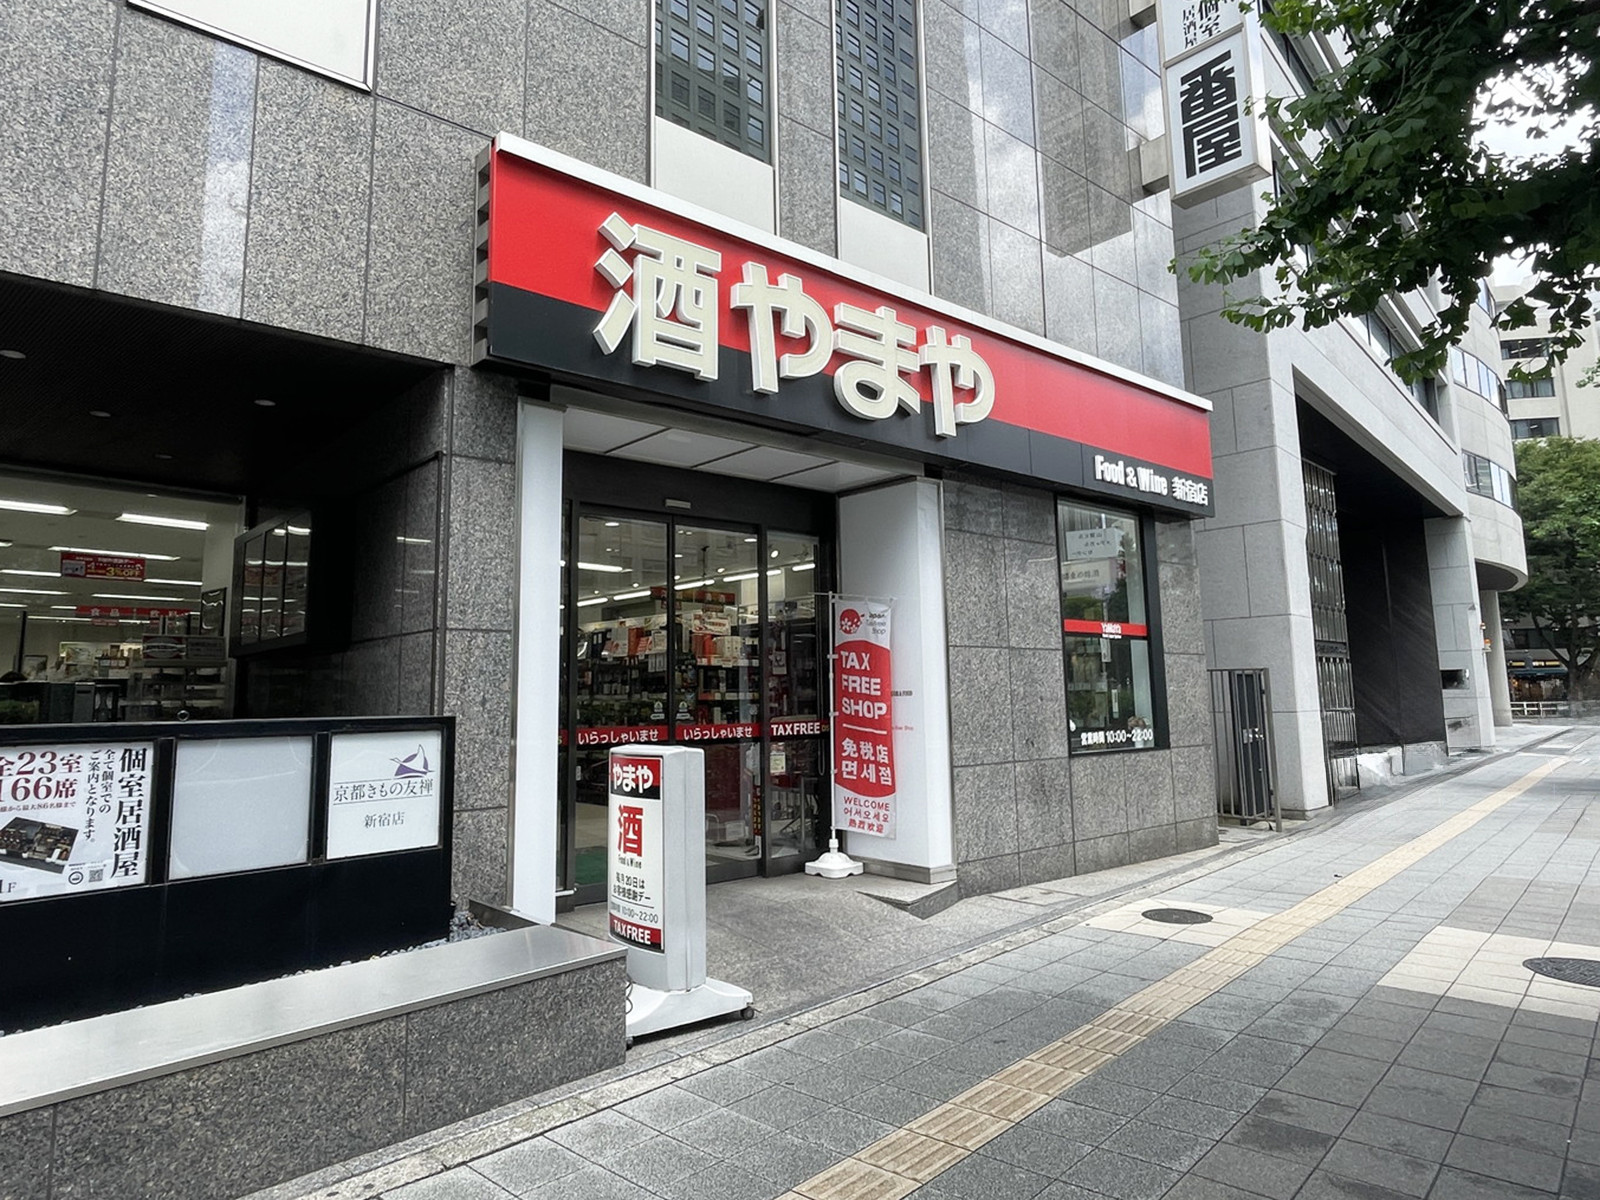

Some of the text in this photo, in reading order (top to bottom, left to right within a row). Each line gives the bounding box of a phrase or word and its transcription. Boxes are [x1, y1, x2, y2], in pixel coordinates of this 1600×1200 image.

[1094, 455, 1209, 506] Food & Wine 新宿店
[840, 650, 871, 671] TAX
[841, 674, 882, 696] FREE
[841, 697, 888, 720] SHOP
[578, 728, 659, 745] いらっしゃいませ
[683, 726, 753, 741] いらっしゃいませ
[841, 737, 889, 764] 免税店
[99, 748, 116, 814] 全て個室での
[612, 762, 654, 794] やまや
[841, 760, 892, 787] 면세점
[83, 749, 102, 843] ご案内となります。
[334, 778, 434, 802] 京都きもの友禅
[110, 747, 148, 879] 個室居酒屋
[843, 796, 891, 812] WELCOME
[364, 811, 406, 829] 新宿店
[617, 804, 644, 858] 酒
